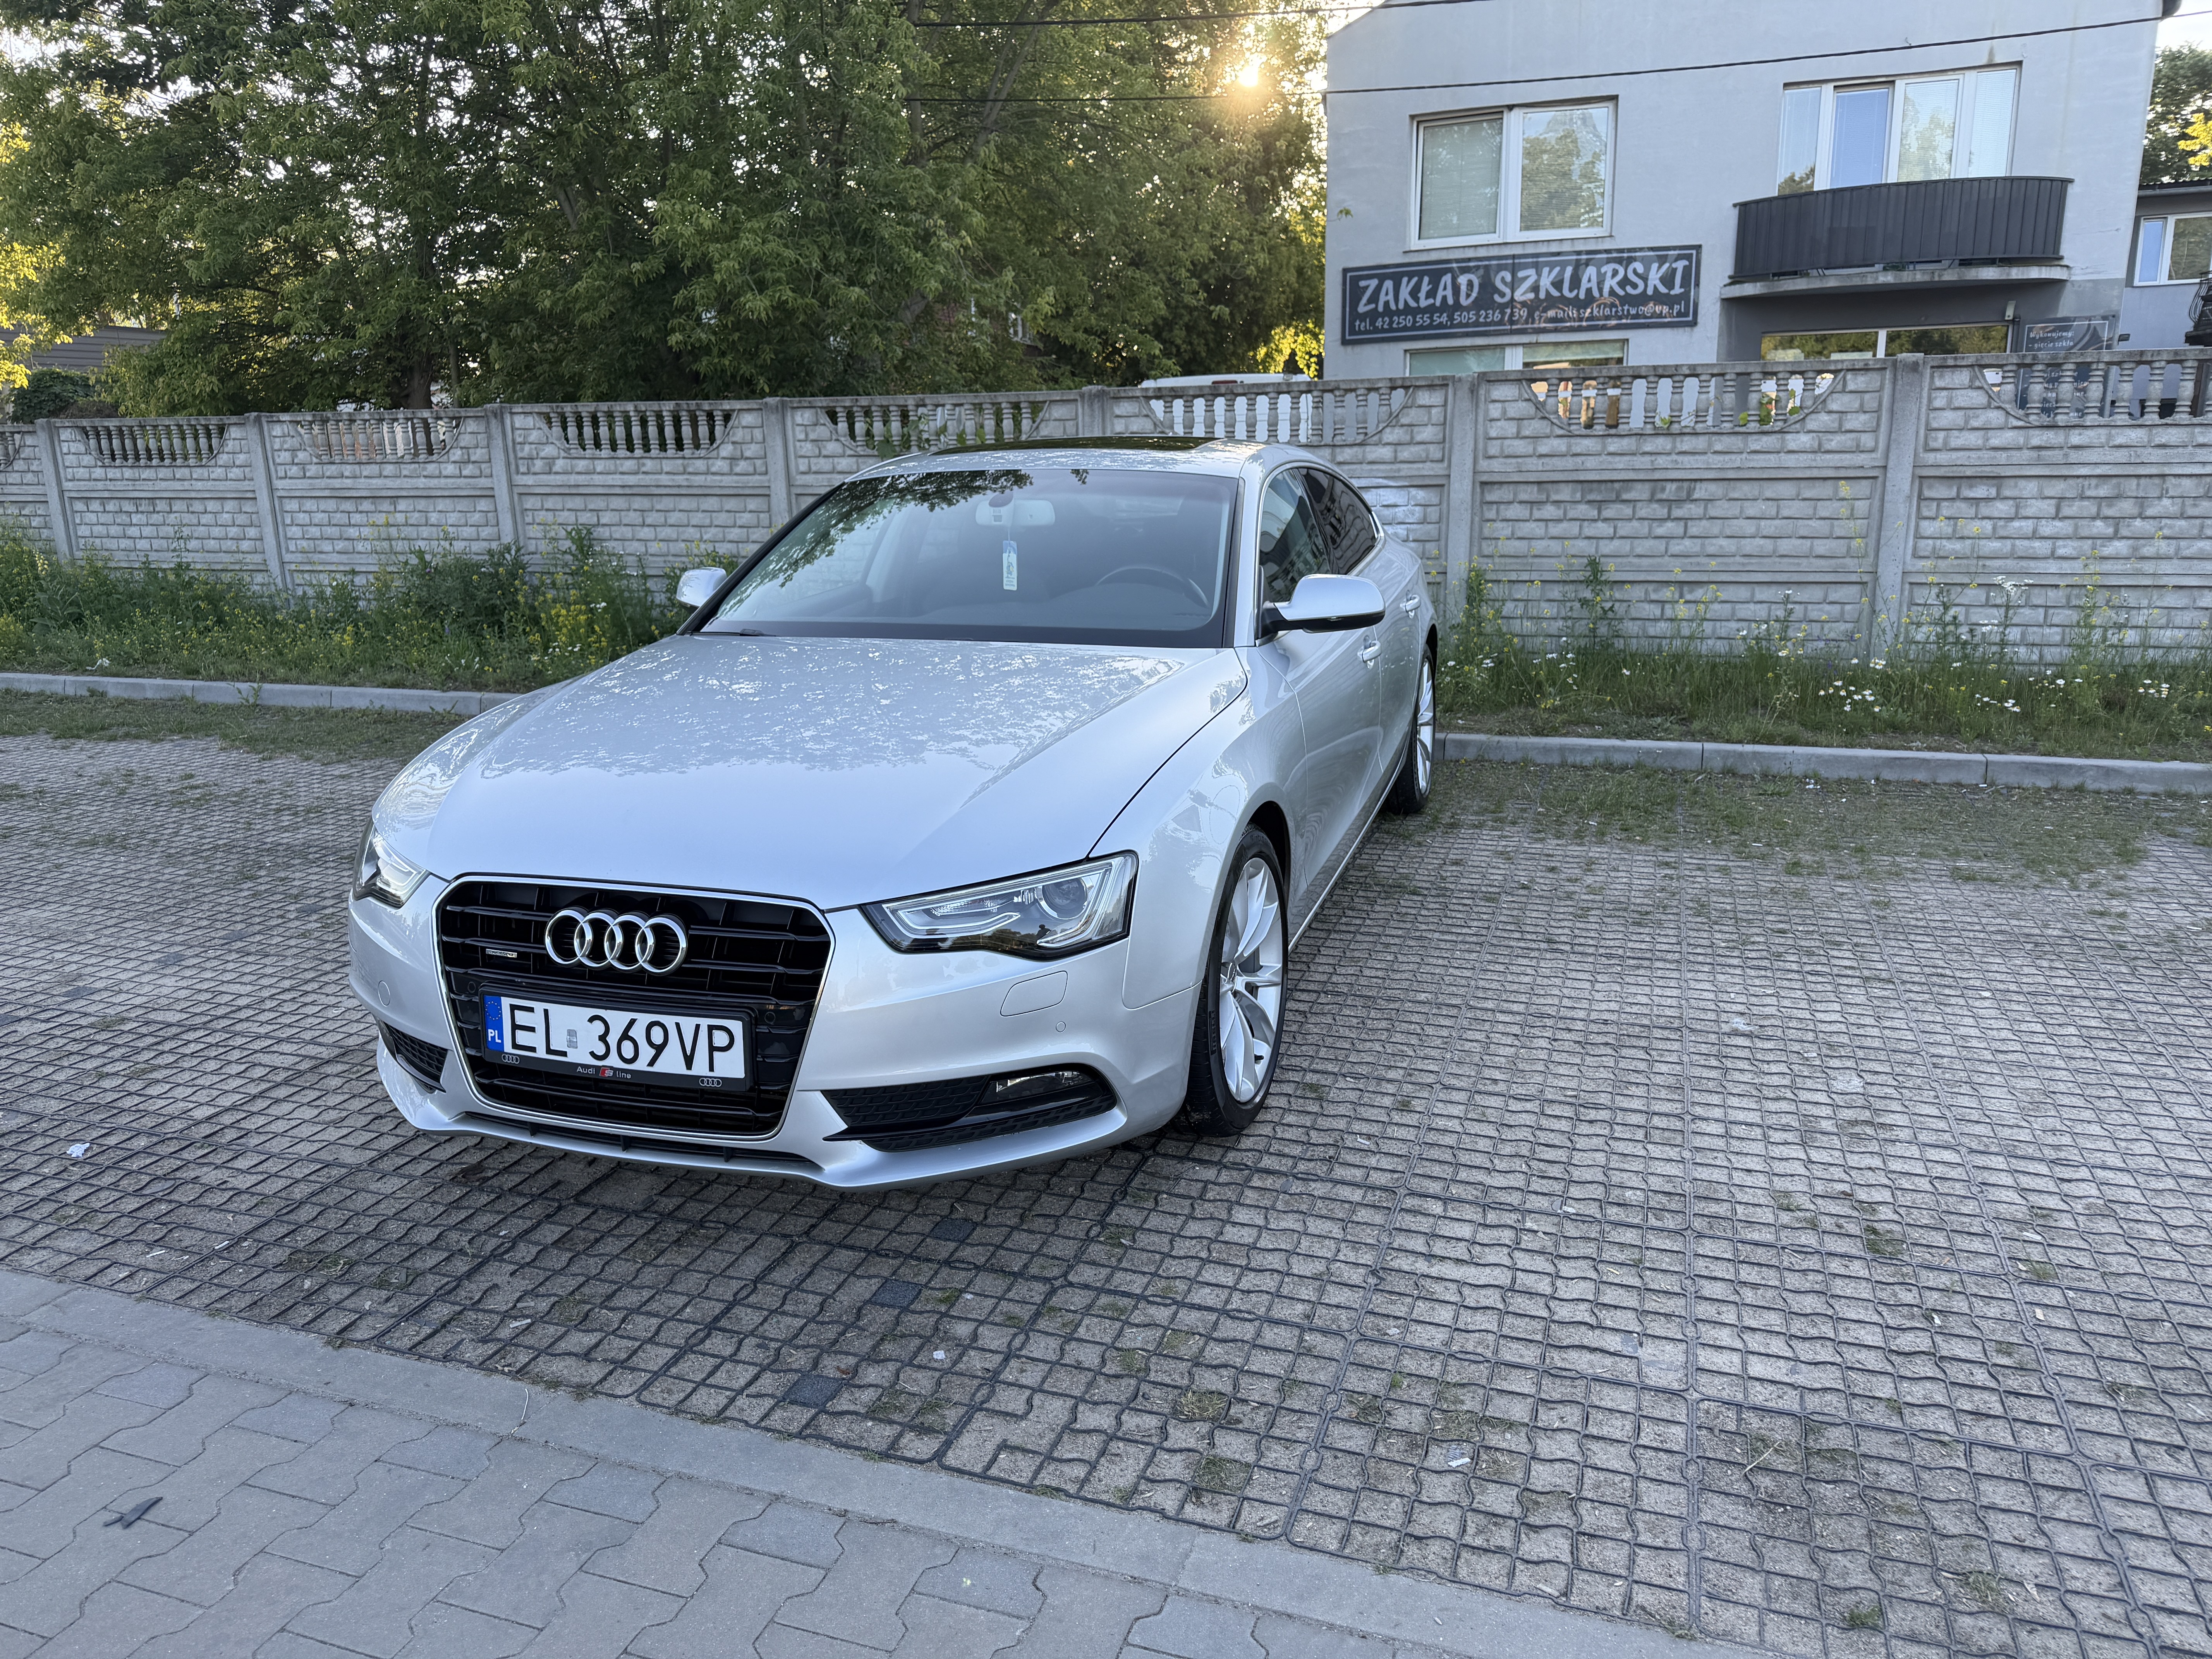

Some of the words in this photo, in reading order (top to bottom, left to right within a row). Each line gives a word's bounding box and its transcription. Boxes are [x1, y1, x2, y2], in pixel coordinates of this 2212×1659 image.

[1357, 273, 1479, 313] ZAKŁAD
[1493, 260, 1689, 304] SZKLARSKI
[1355, 318, 1372, 331] tel.
[1375, 317, 1389, 329] 42
[1392, 315, 1413, 328] 250
[1415, 314, 1430, 326] 55
[1432, 313, 1450, 326] 54,
[1453, 311, 1476, 324] 505
[1479, 309, 1501, 322] 236
[1504, 308, 1528, 321] 739
[1534, 305, 1576, 320] e-mail:
[1579, 301, 1685, 318] szklarstwo@up.pl
[2030, 330, 2074, 339] Wykonujemy:
[488, 1029, 501, 1043] PL
[509, 1003, 568, 1058] EL
[587, 1014, 735, 1072] 369VP
[576, 1066, 595, 1074] Audi
[616, 1070, 631, 1079] line
